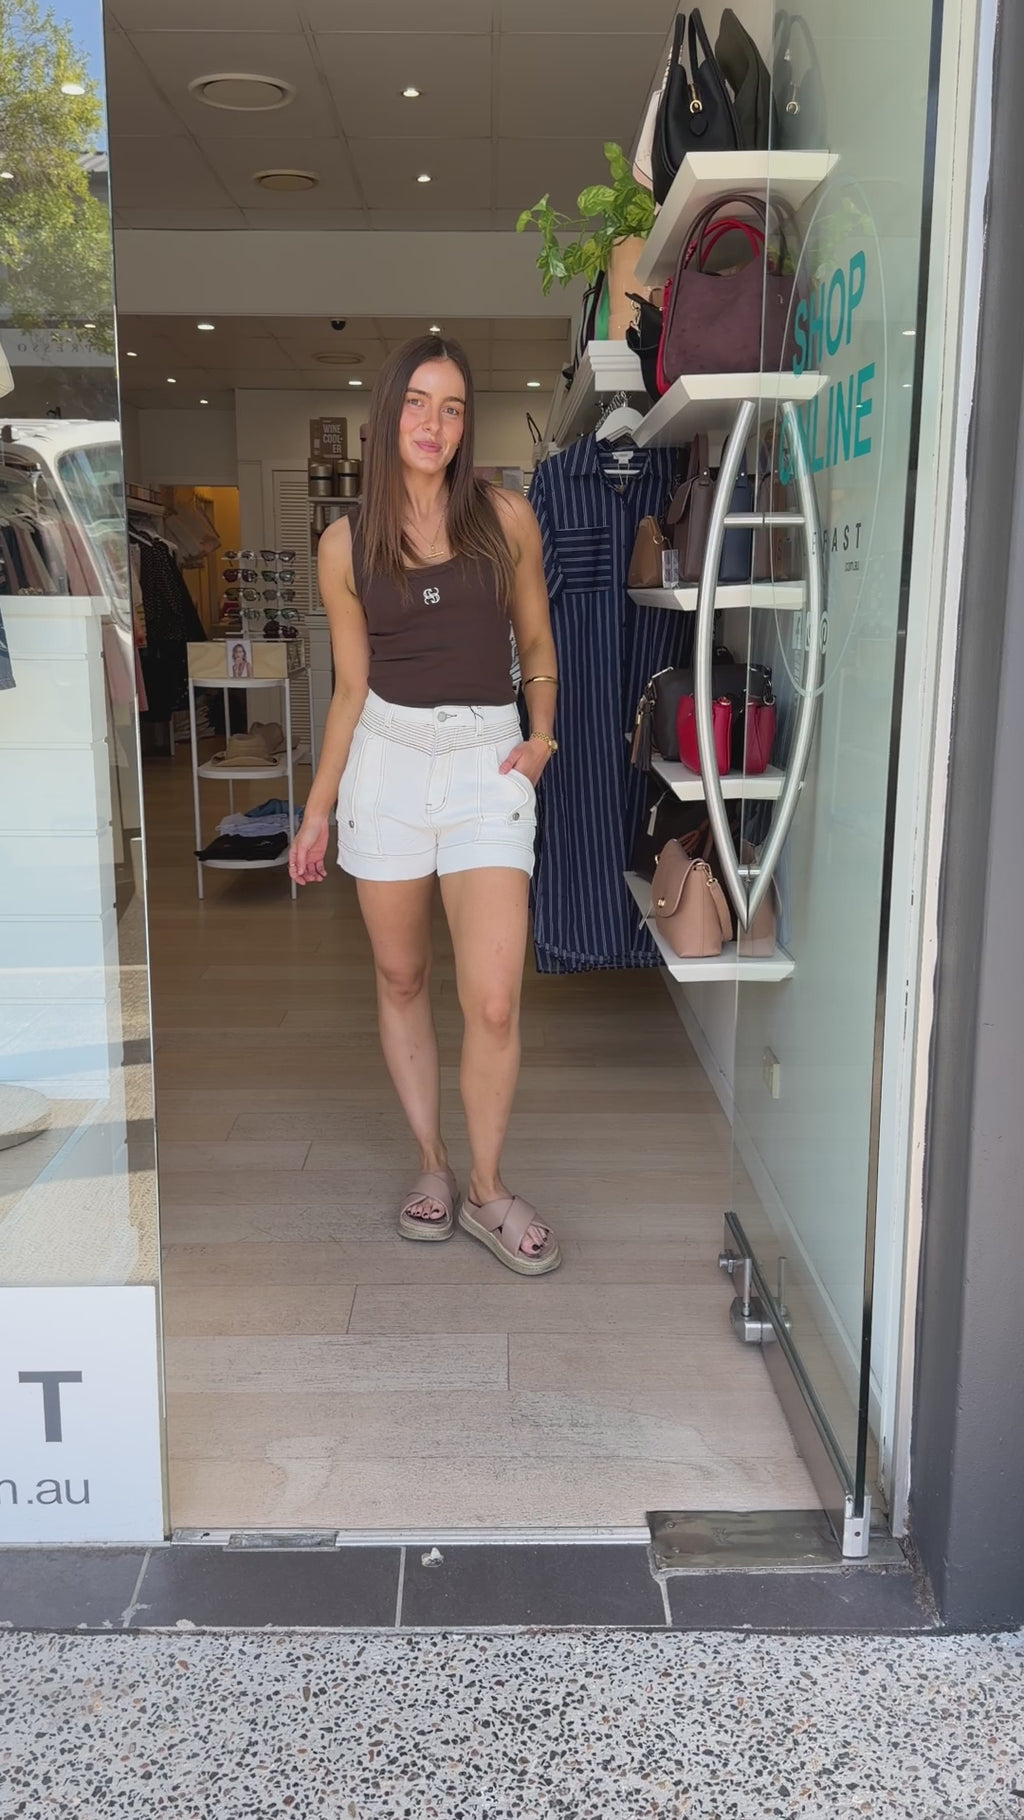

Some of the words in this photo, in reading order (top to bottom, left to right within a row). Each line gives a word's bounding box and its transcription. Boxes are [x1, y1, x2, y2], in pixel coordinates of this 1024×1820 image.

[793, 250, 866, 378] SHOP
[322, 424, 341, 433] WINE
[333, 444, 341, 453] ER
[778, 362, 875, 486] ONLINE
